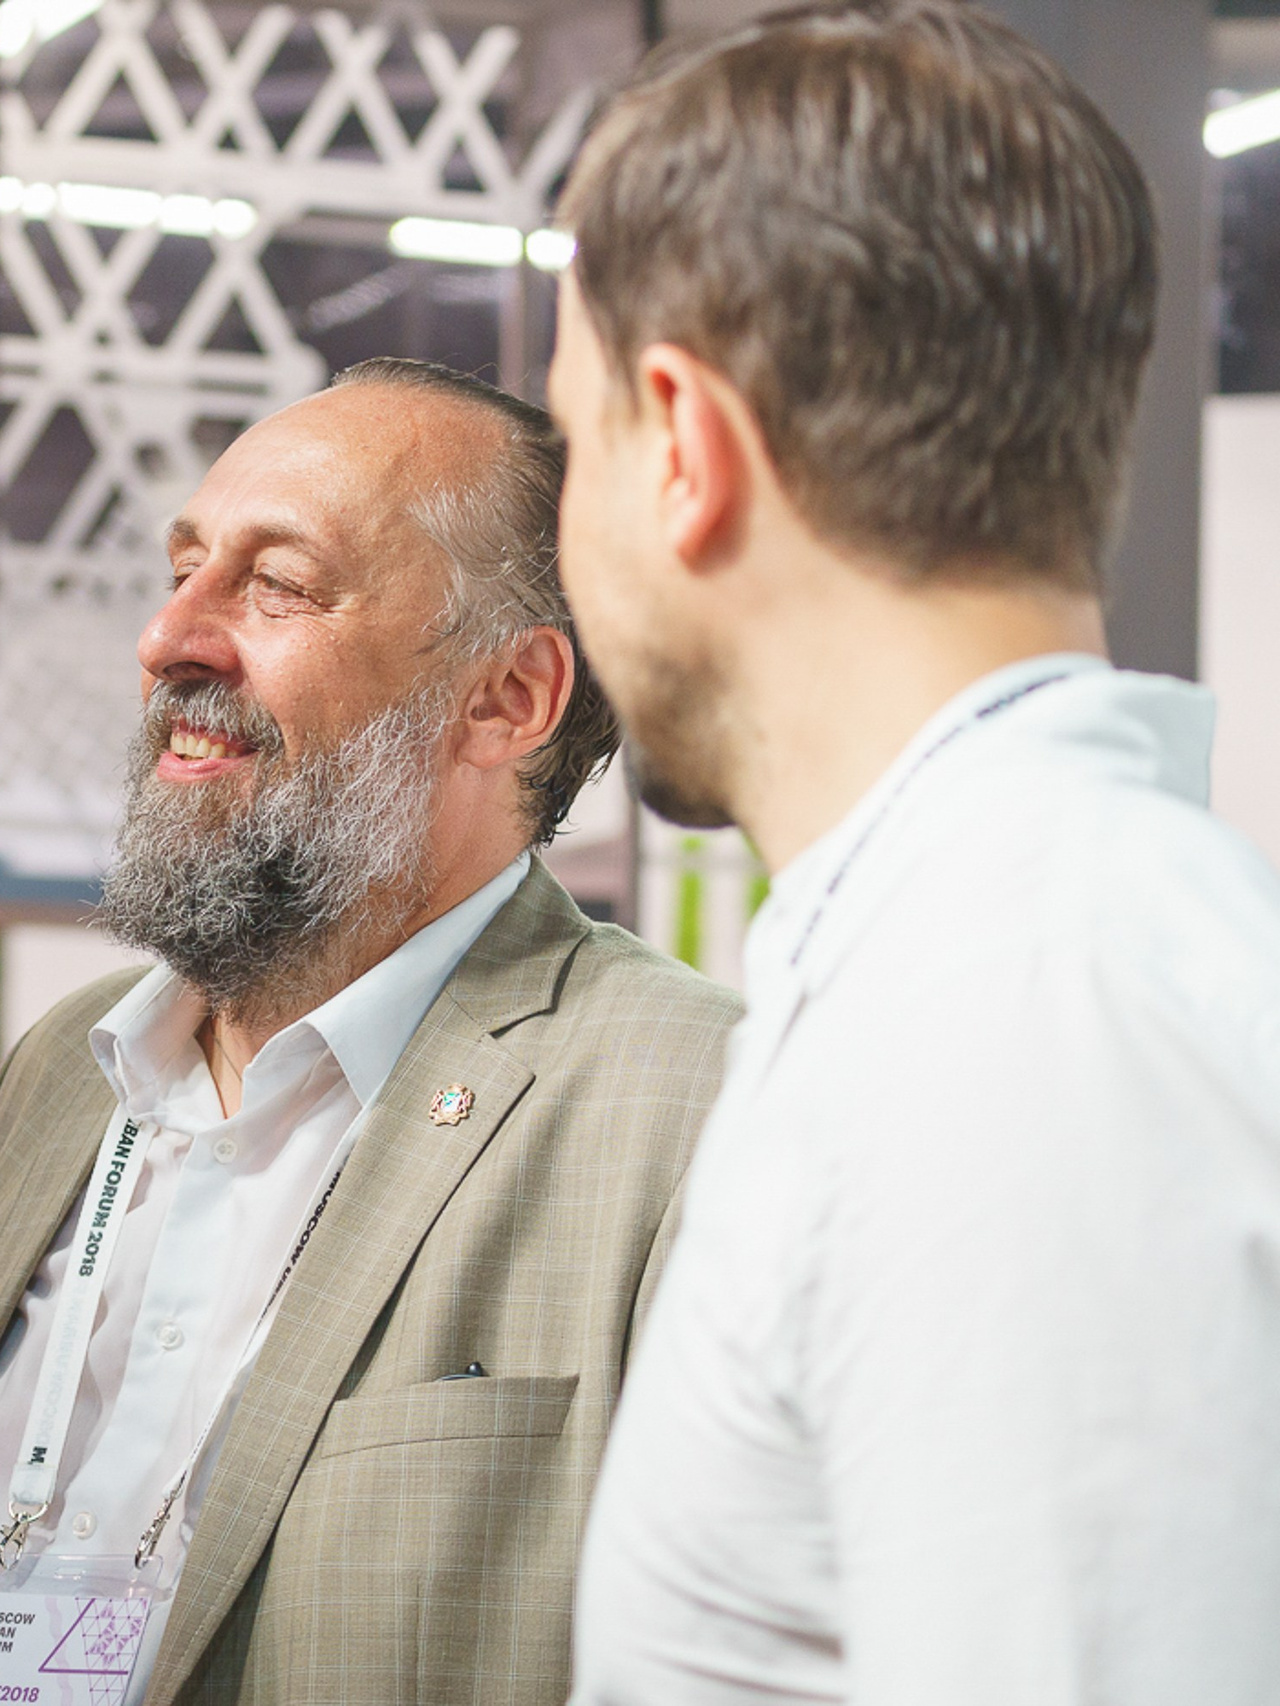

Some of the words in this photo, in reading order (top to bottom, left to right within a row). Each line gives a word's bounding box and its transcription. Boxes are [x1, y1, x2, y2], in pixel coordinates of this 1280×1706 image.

[114, 1118, 140, 1159] BAN
[91, 1160, 127, 1228] FORUM
[78, 1230, 104, 1278] 2018
